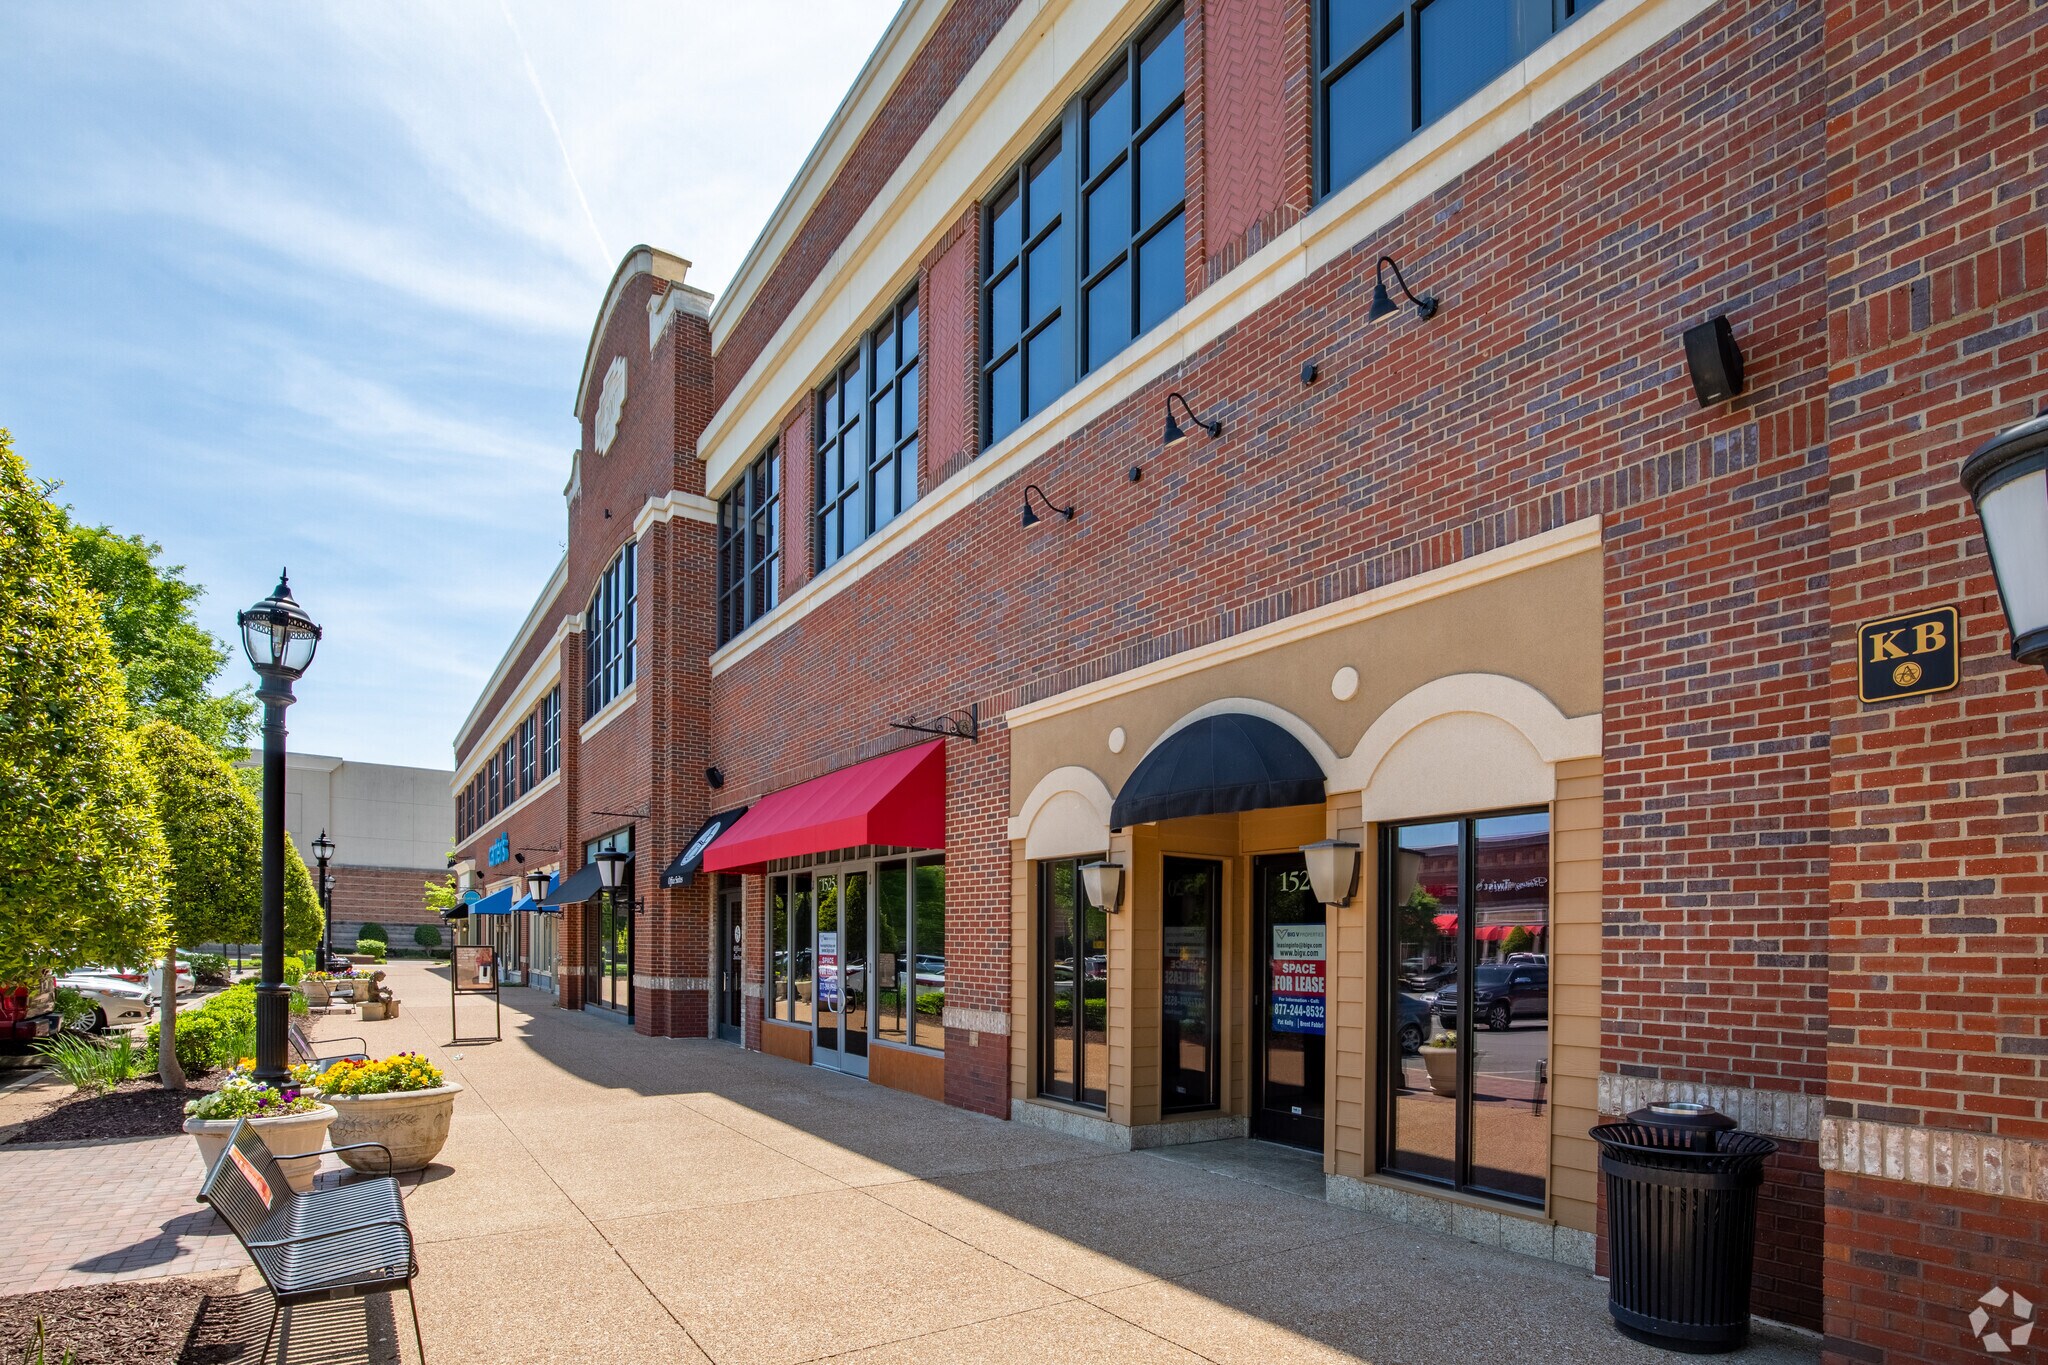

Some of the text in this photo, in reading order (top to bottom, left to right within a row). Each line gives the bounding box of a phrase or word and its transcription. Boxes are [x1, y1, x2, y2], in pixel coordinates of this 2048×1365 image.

[1279, 870, 1311, 893] 152
[1280, 949, 1319, 958] www.bigv.com
[1282, 963, 1316, 974] SPACE
[1274, 975, 1325, 993] FOR LEASE
[1274, 1003, 1325, 1018] 877-244-8532
